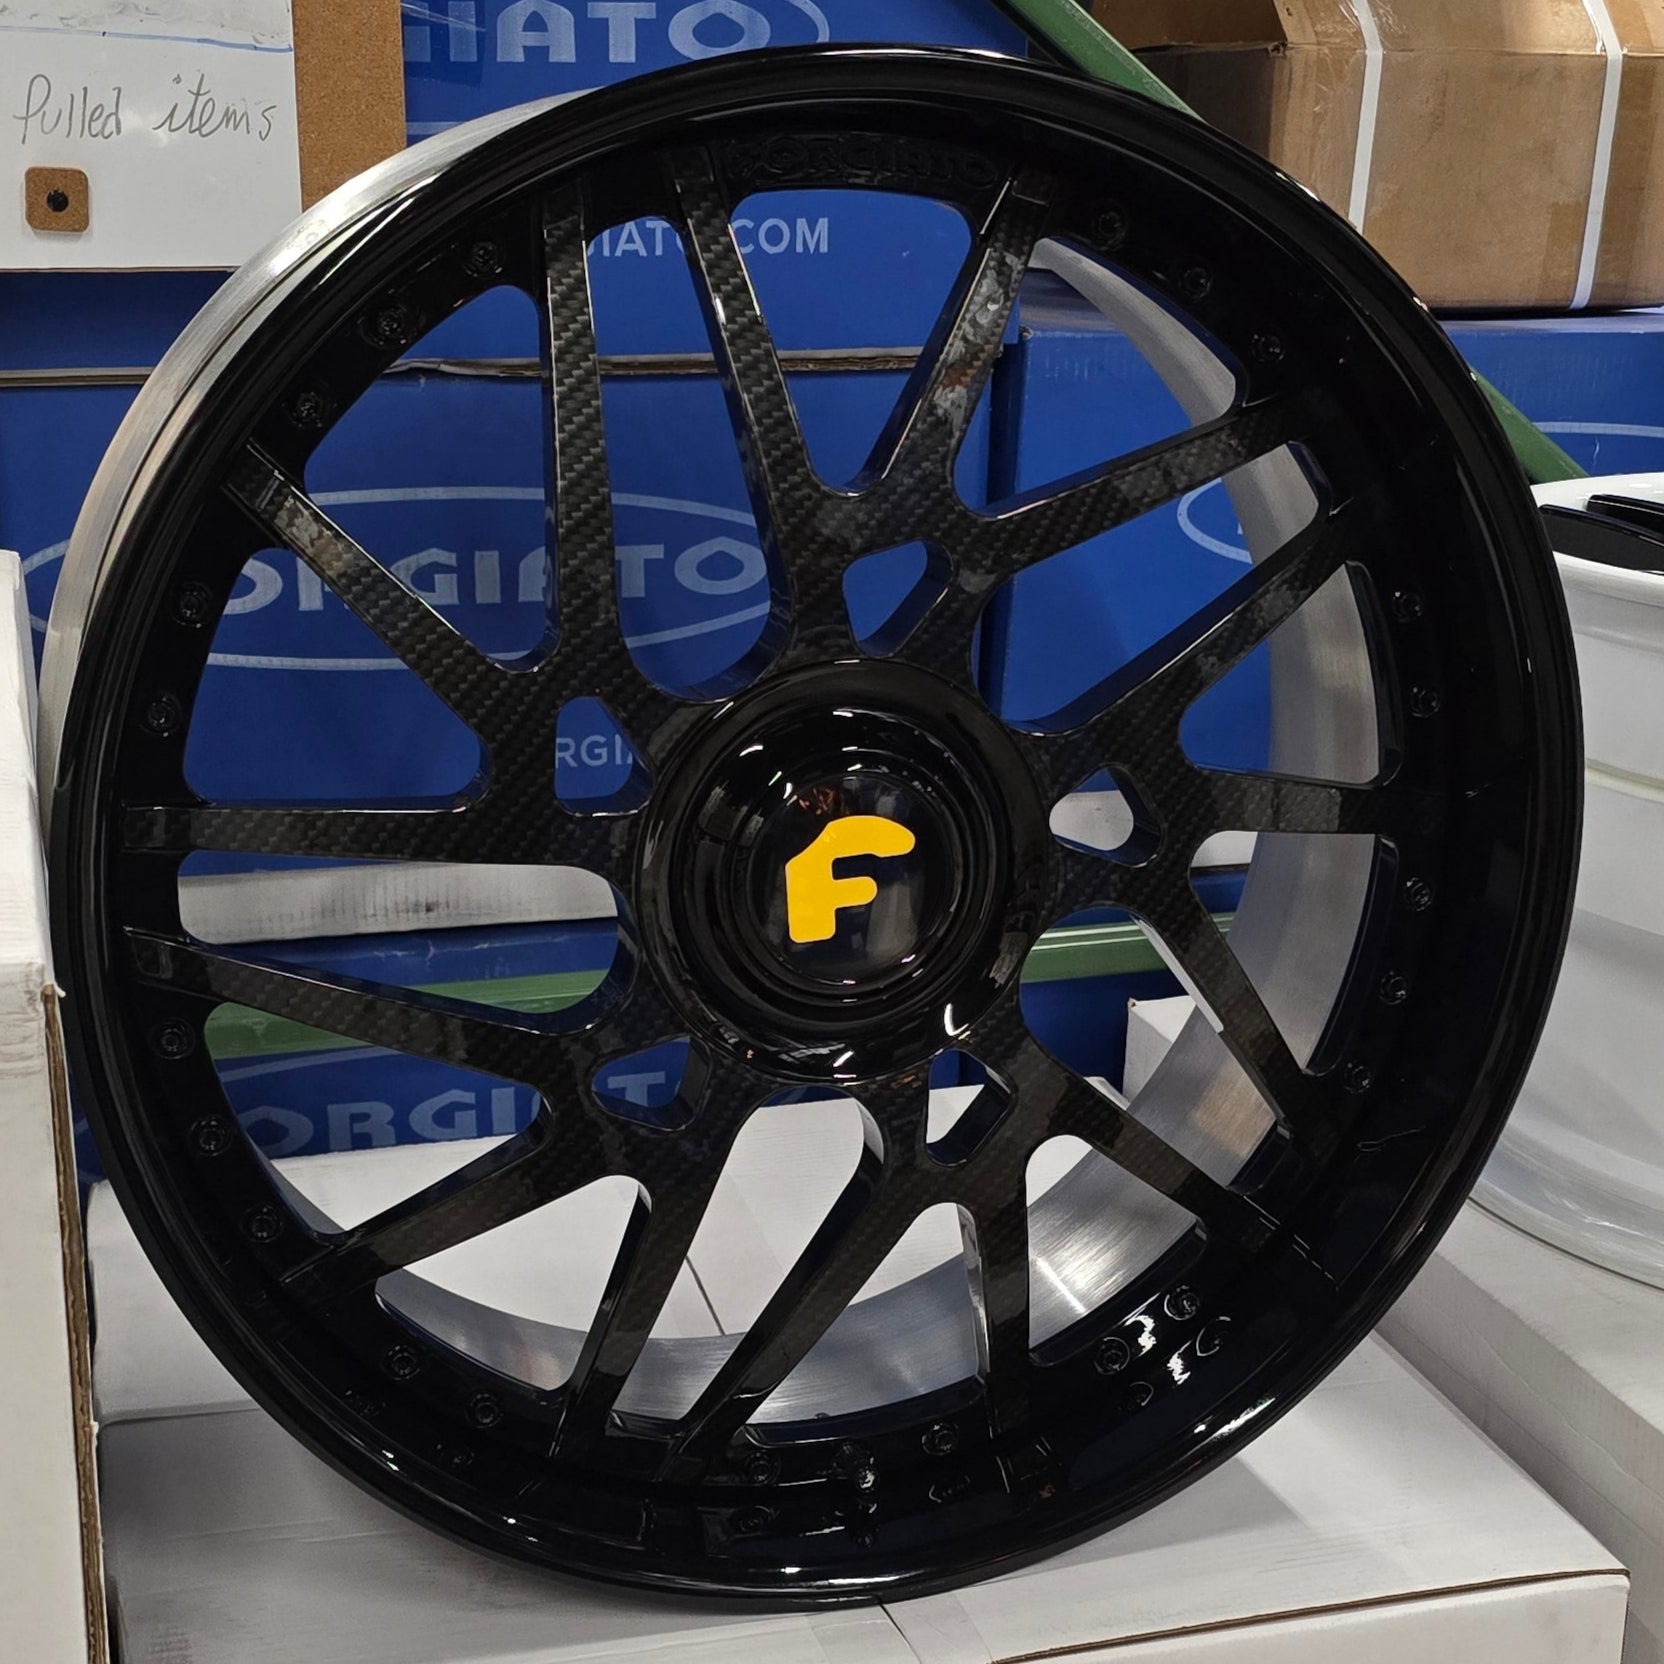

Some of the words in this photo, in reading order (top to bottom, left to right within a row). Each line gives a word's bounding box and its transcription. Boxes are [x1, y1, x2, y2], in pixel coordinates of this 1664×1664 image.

[152, 73, 277, 141] items
[555, 733, 633, 769] RGI
[785, 815, 916, 943] F
